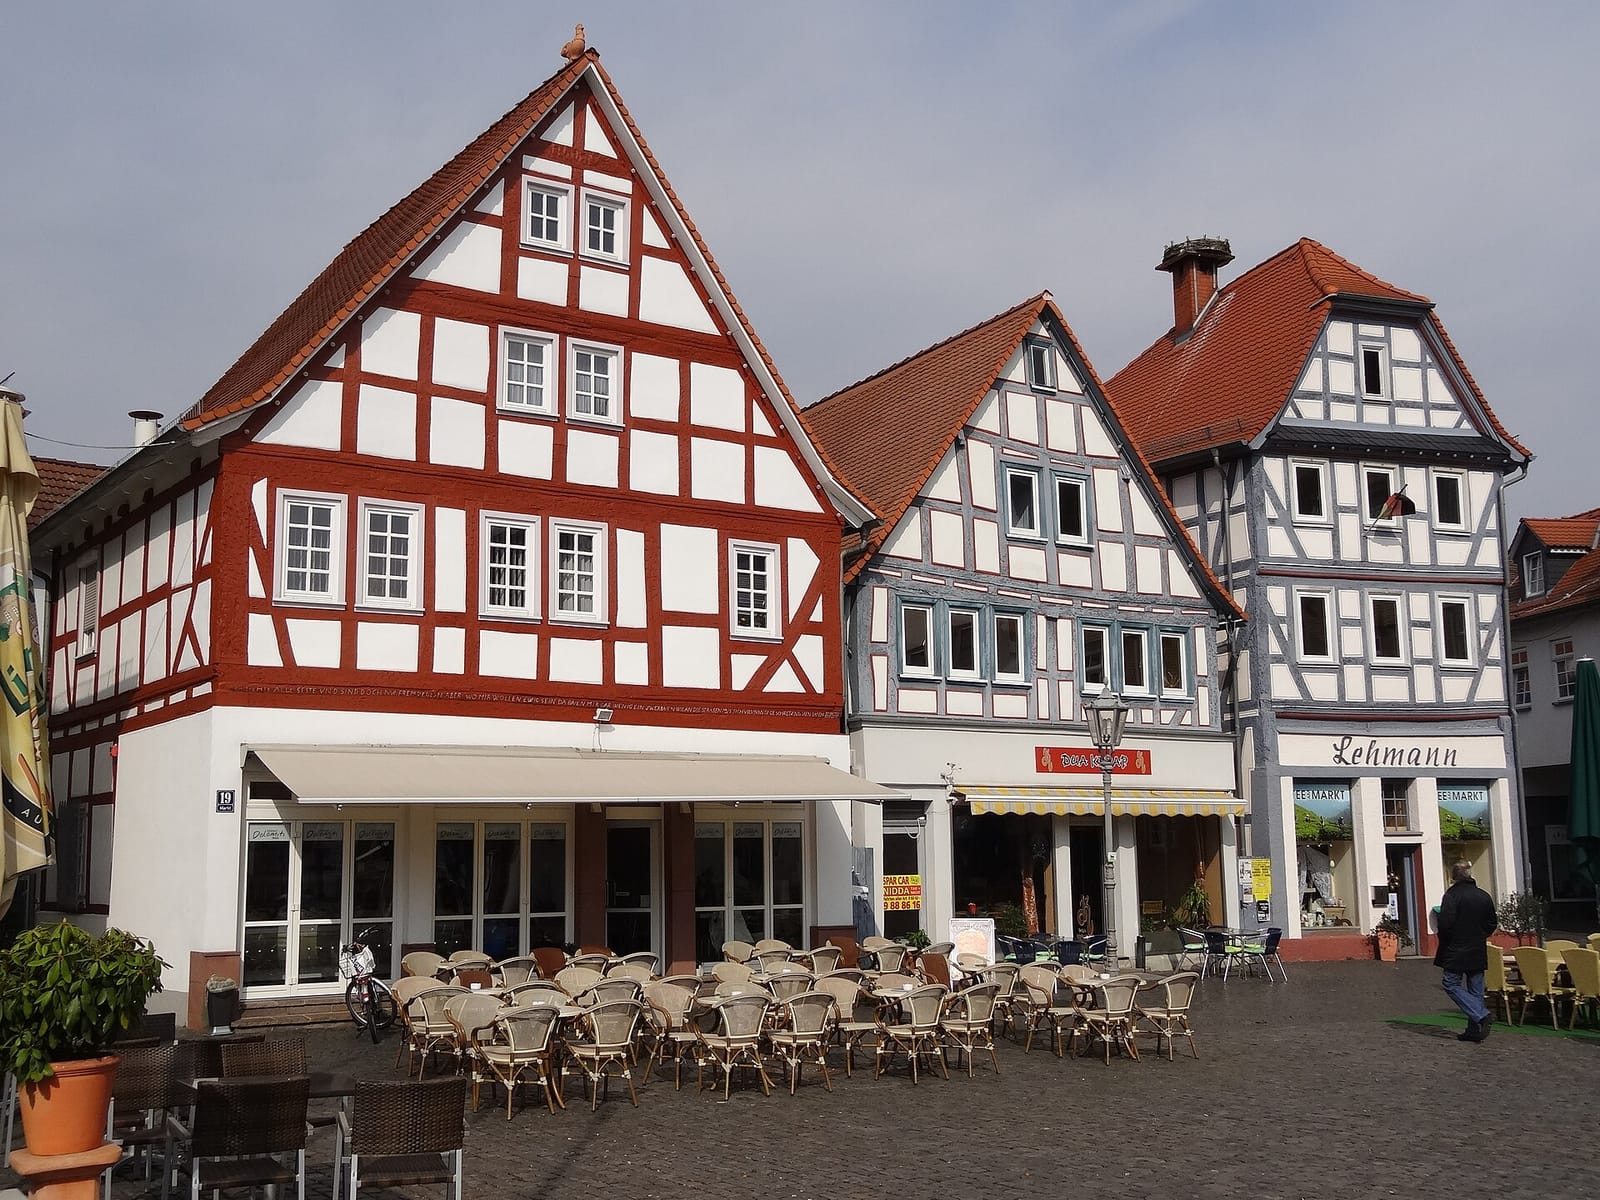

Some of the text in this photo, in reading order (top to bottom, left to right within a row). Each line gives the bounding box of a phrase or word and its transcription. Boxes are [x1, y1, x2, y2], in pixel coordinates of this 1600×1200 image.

[1332, 735, 1457, 767] Lehmann
[1061, 753, 1089, 768] DUA
[220, 792, 231, 804] 19
[1311, 790, 1345, 800] MARKT
[1452, 791, 1484, 801] MARKT
[883, 886, 910, 895] NIDDA
